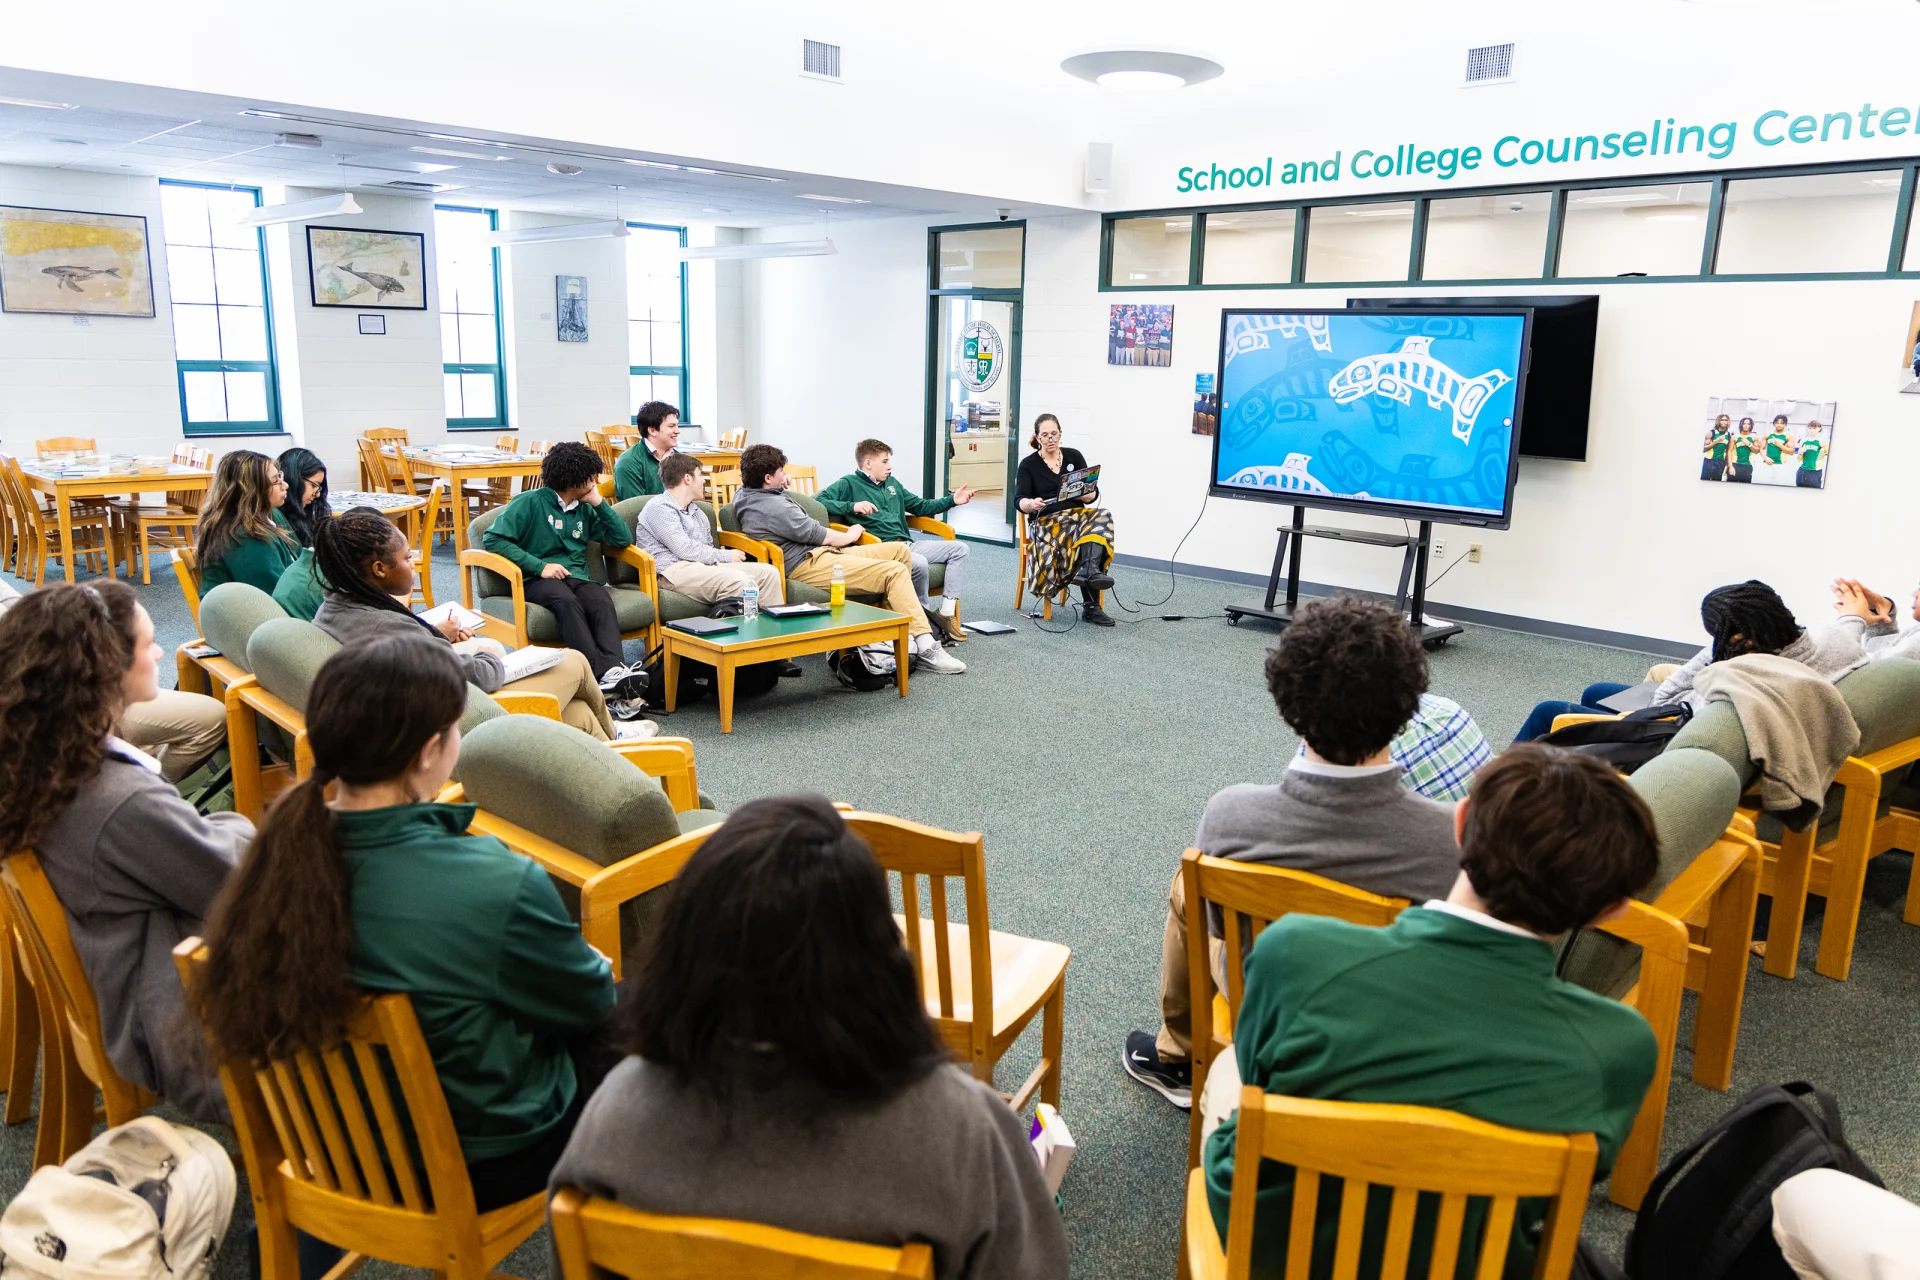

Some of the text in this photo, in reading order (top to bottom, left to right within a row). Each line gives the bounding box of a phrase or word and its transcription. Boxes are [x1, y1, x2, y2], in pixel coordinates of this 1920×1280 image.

[1177, 156, 1273, 193] School
[1281, 151, 1342, 184] and
[1351, 143, 1482, 180] College
[1493, 118, 1738, 168] Counseling
